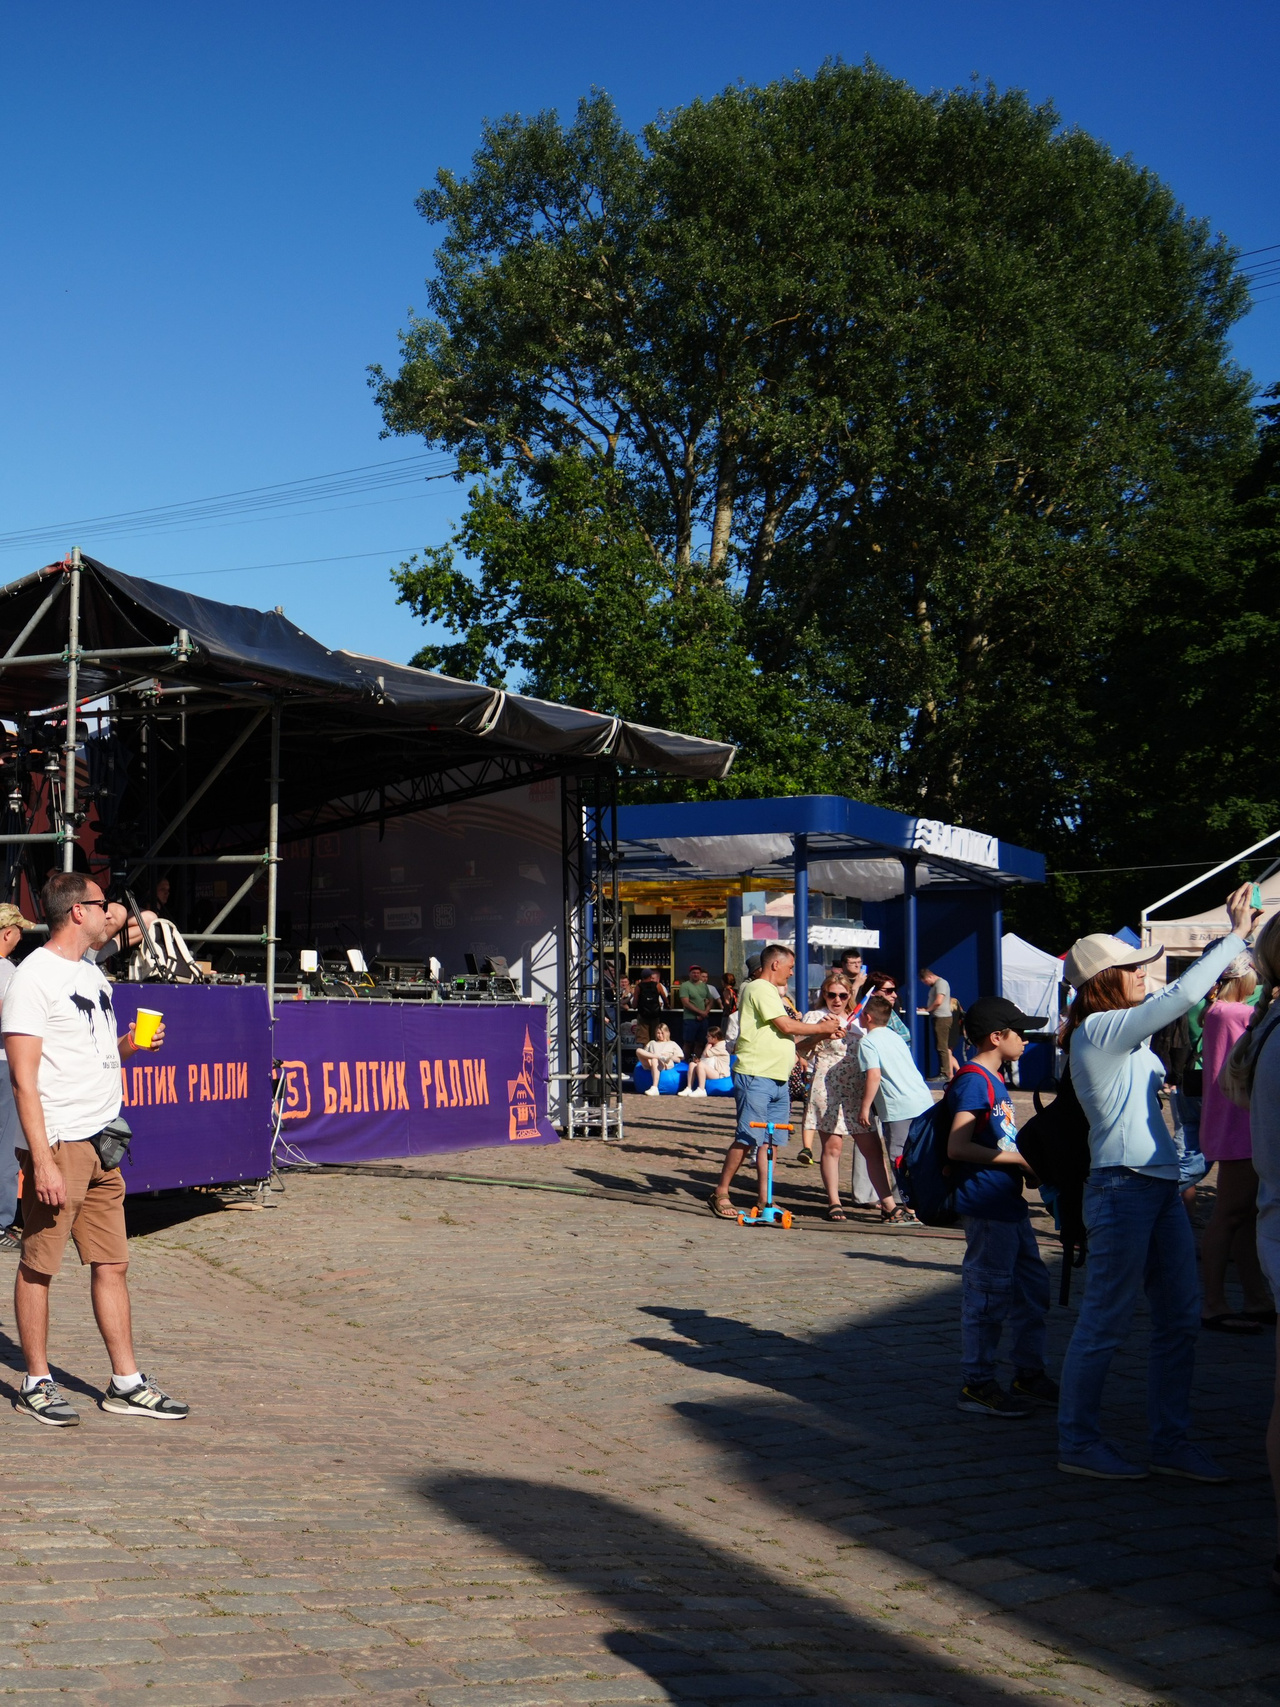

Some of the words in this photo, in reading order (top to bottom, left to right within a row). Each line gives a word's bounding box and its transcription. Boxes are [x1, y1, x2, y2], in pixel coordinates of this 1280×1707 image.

[121, 1065, 178, 1107] АЛТИК
[188, 1061, 248, 1102] РАЛЛИ
[322, 1060, 410, 1114] БАЛТИК
[419, 1058, 490, 1109] РАЛЛИ
